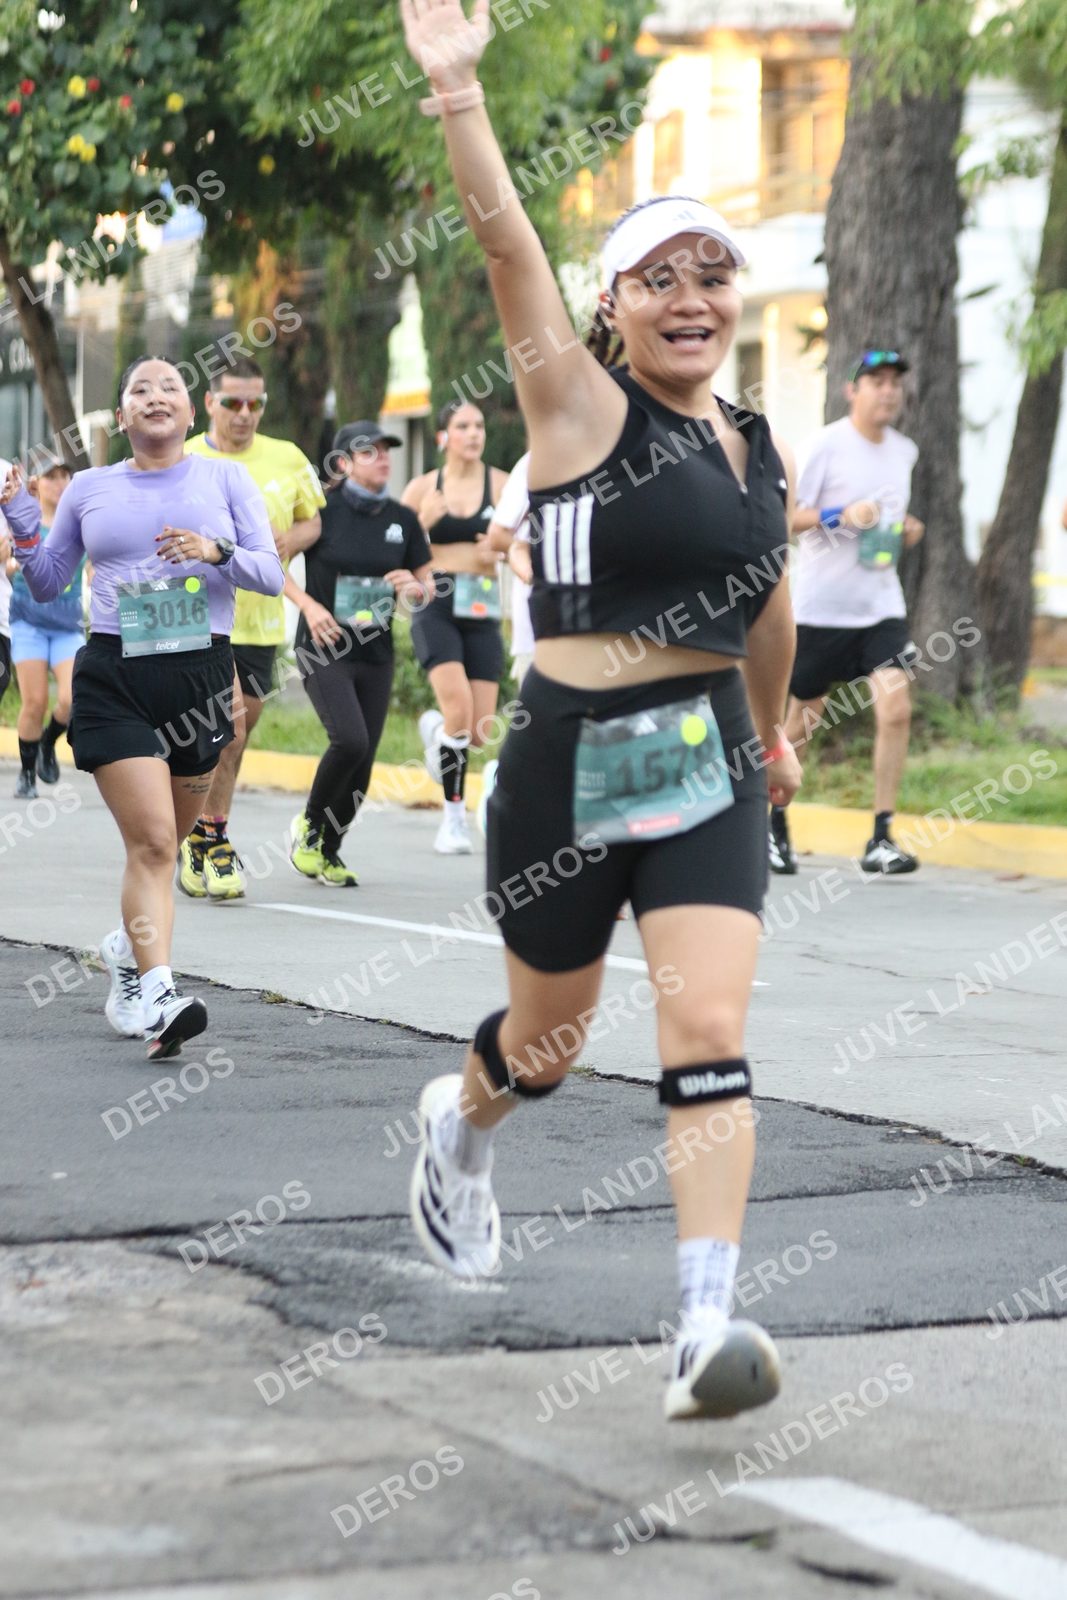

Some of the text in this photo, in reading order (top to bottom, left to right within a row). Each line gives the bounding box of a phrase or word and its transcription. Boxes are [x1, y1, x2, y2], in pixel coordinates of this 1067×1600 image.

[143, 597, 206, 630] 3016
[155, 641, 181, 651] telcel
[678, 1071, 746, 1097] Wilson
